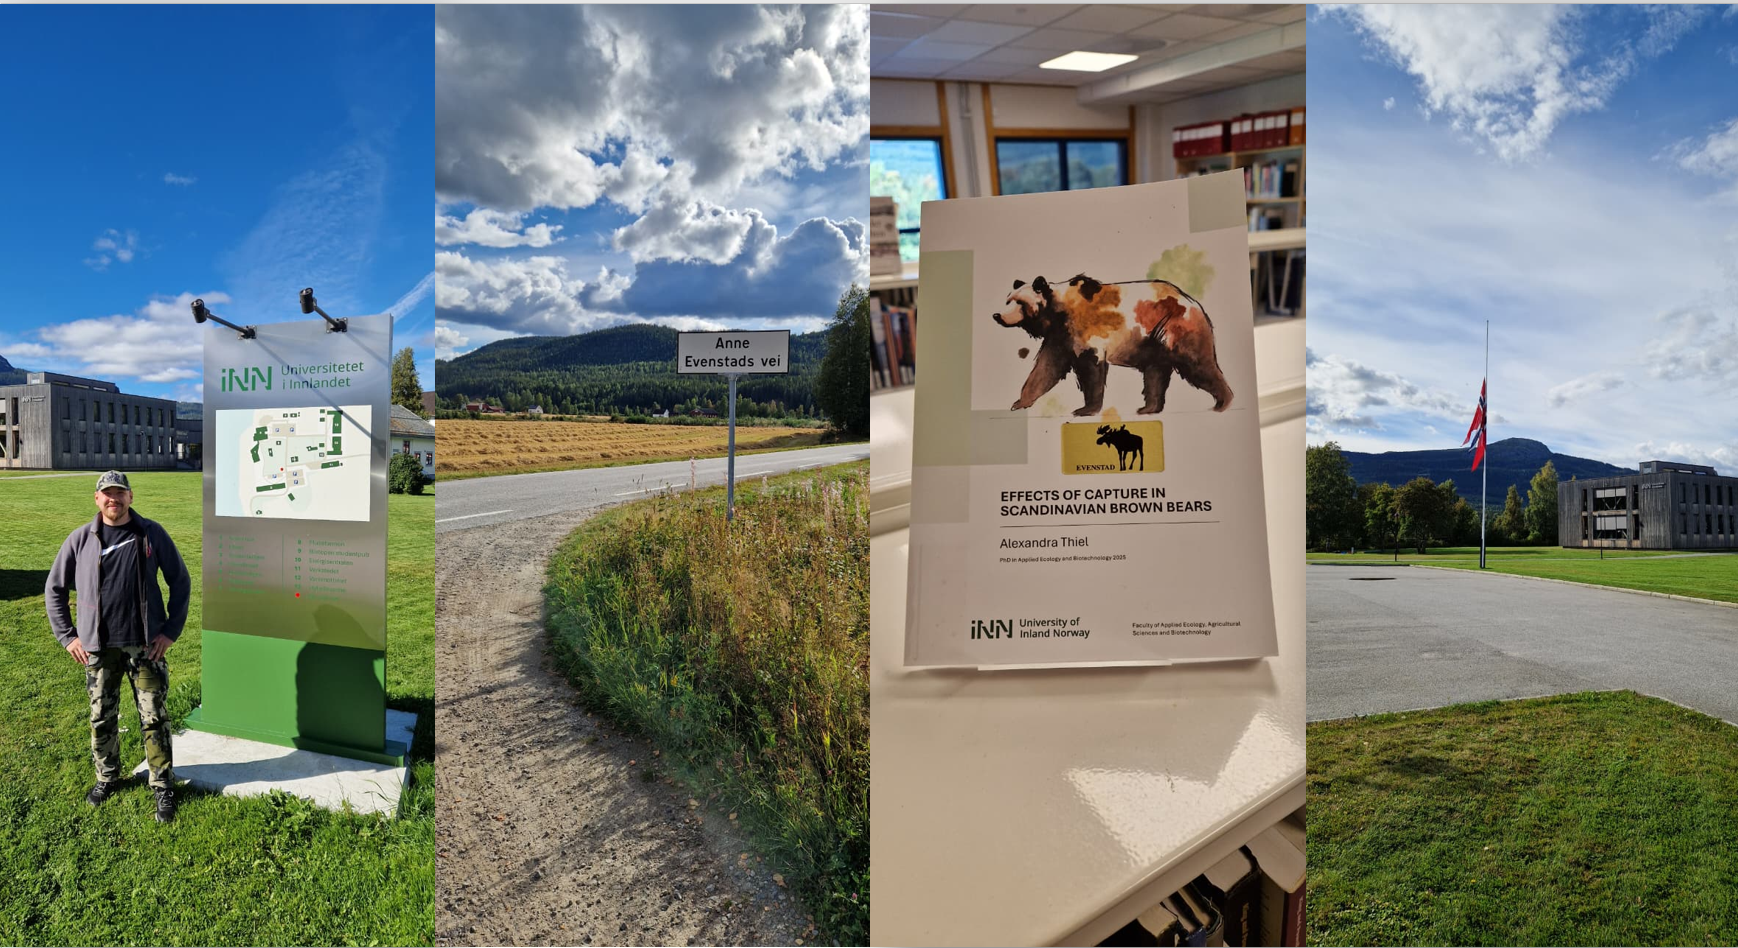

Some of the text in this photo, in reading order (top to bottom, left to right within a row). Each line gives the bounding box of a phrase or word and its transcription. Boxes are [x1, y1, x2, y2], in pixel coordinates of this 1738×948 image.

[715, 337, 750, 349] Anne
[685, 355, 781, 367] Evenstads vei
[281, 361, 364, 375] Universitetet
[289, 377, 351, 389] Innlandet
[1001, 487, 1166, 502] EFFECTS OF CAPTURE IN
[1000, 500, 1213, 517] SCANDINAVIAN BROWN BEARS
[1000, 536, 1089, 549] Alexandra Thiel
[1019, 617, 1081, 628] University of
[1020, 629, 1091, 639] Inland Norway
